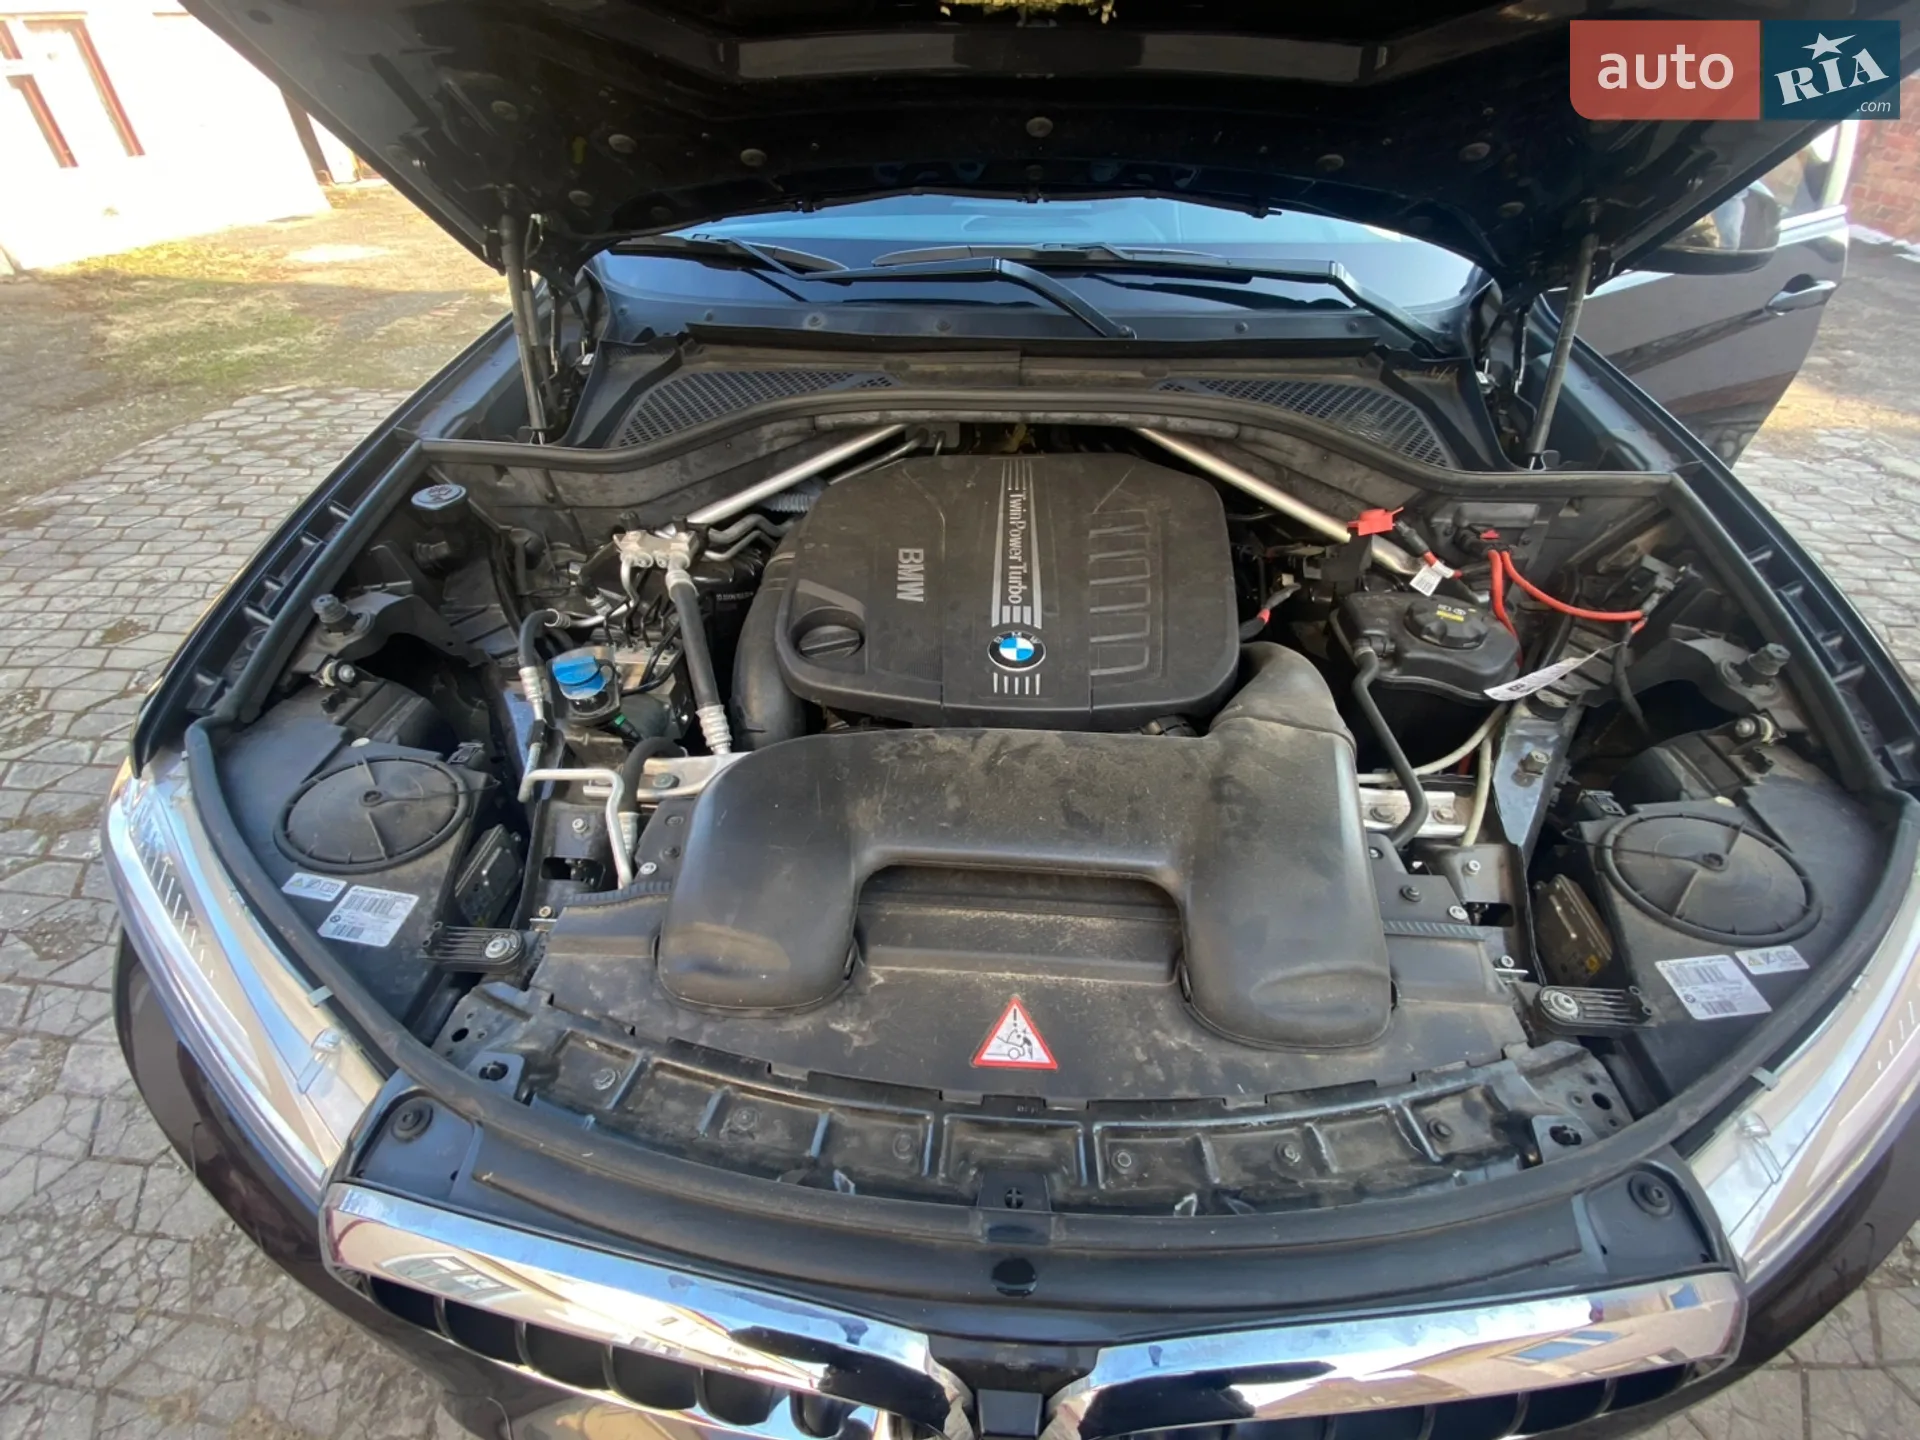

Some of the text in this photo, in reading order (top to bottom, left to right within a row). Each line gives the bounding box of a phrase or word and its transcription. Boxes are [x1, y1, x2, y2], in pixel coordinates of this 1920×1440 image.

[1007, 488, 1028, 604] TwinPower Turbo
[897, 548, 924, 602] BMW
[993, 631, 1042, 644] BMW
